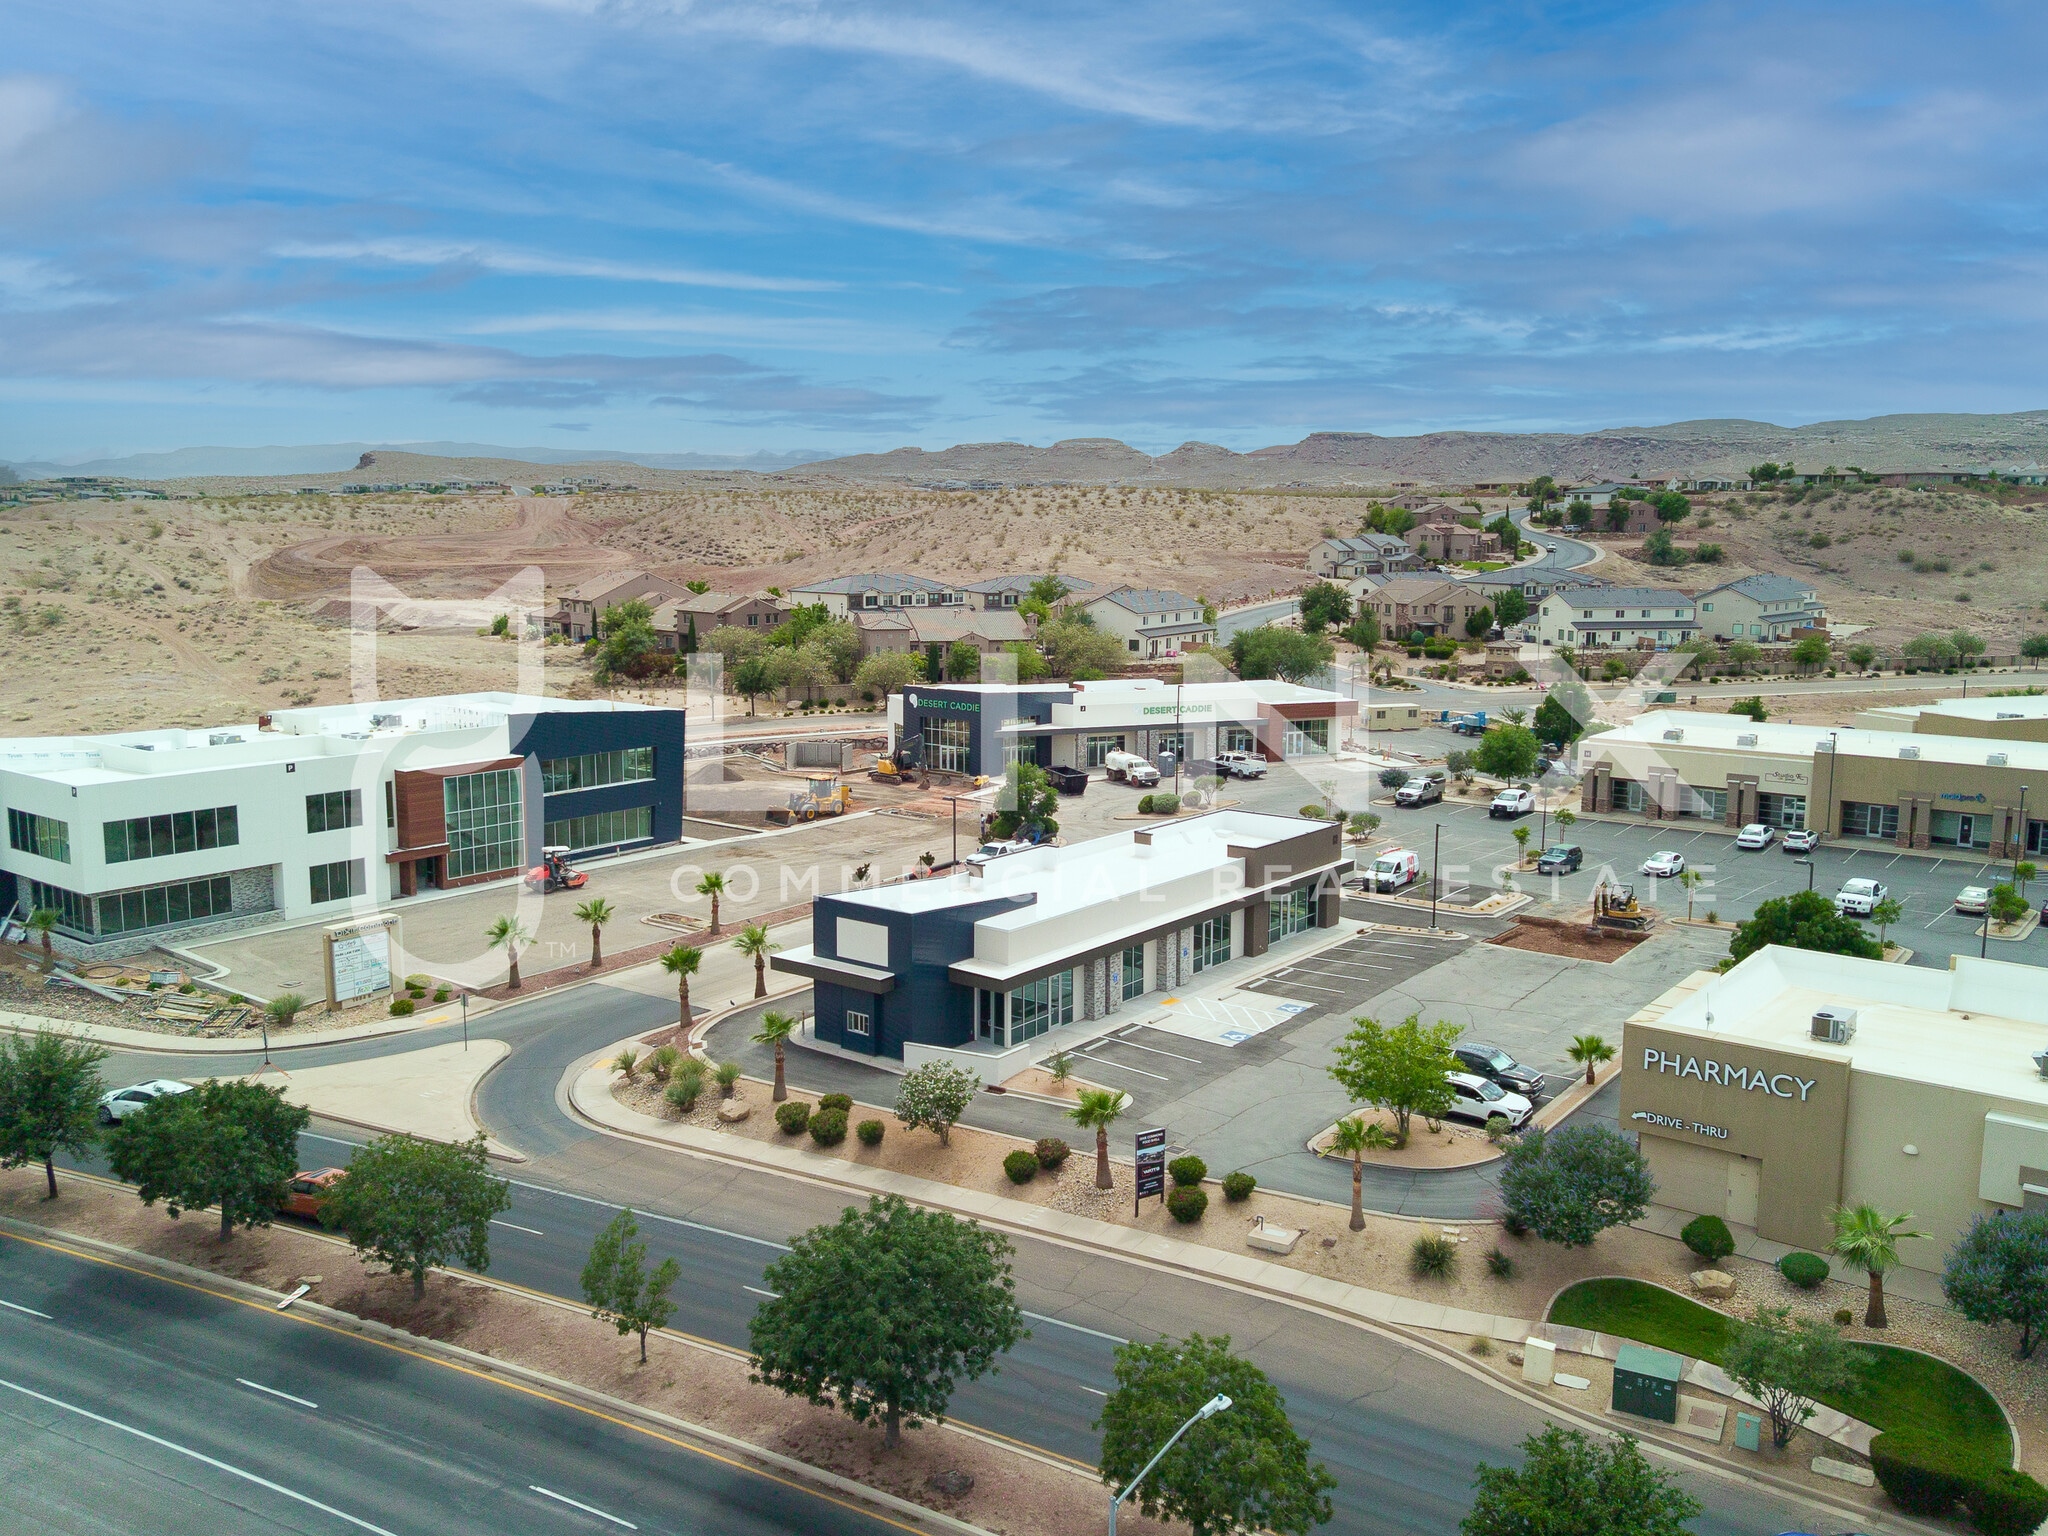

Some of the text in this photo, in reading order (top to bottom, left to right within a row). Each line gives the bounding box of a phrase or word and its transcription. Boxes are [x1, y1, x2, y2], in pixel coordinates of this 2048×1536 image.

[918, 699, 980, 712] DESERT CADDIE
[1143, 704, 1213, 715] DESERT CADDIE
[1643, 1048, 1816, 1101] PHARMACY
[1647, 1113, 1682, 1130] DRIVE
[1692, 1122, 1728, 1139] THRU
